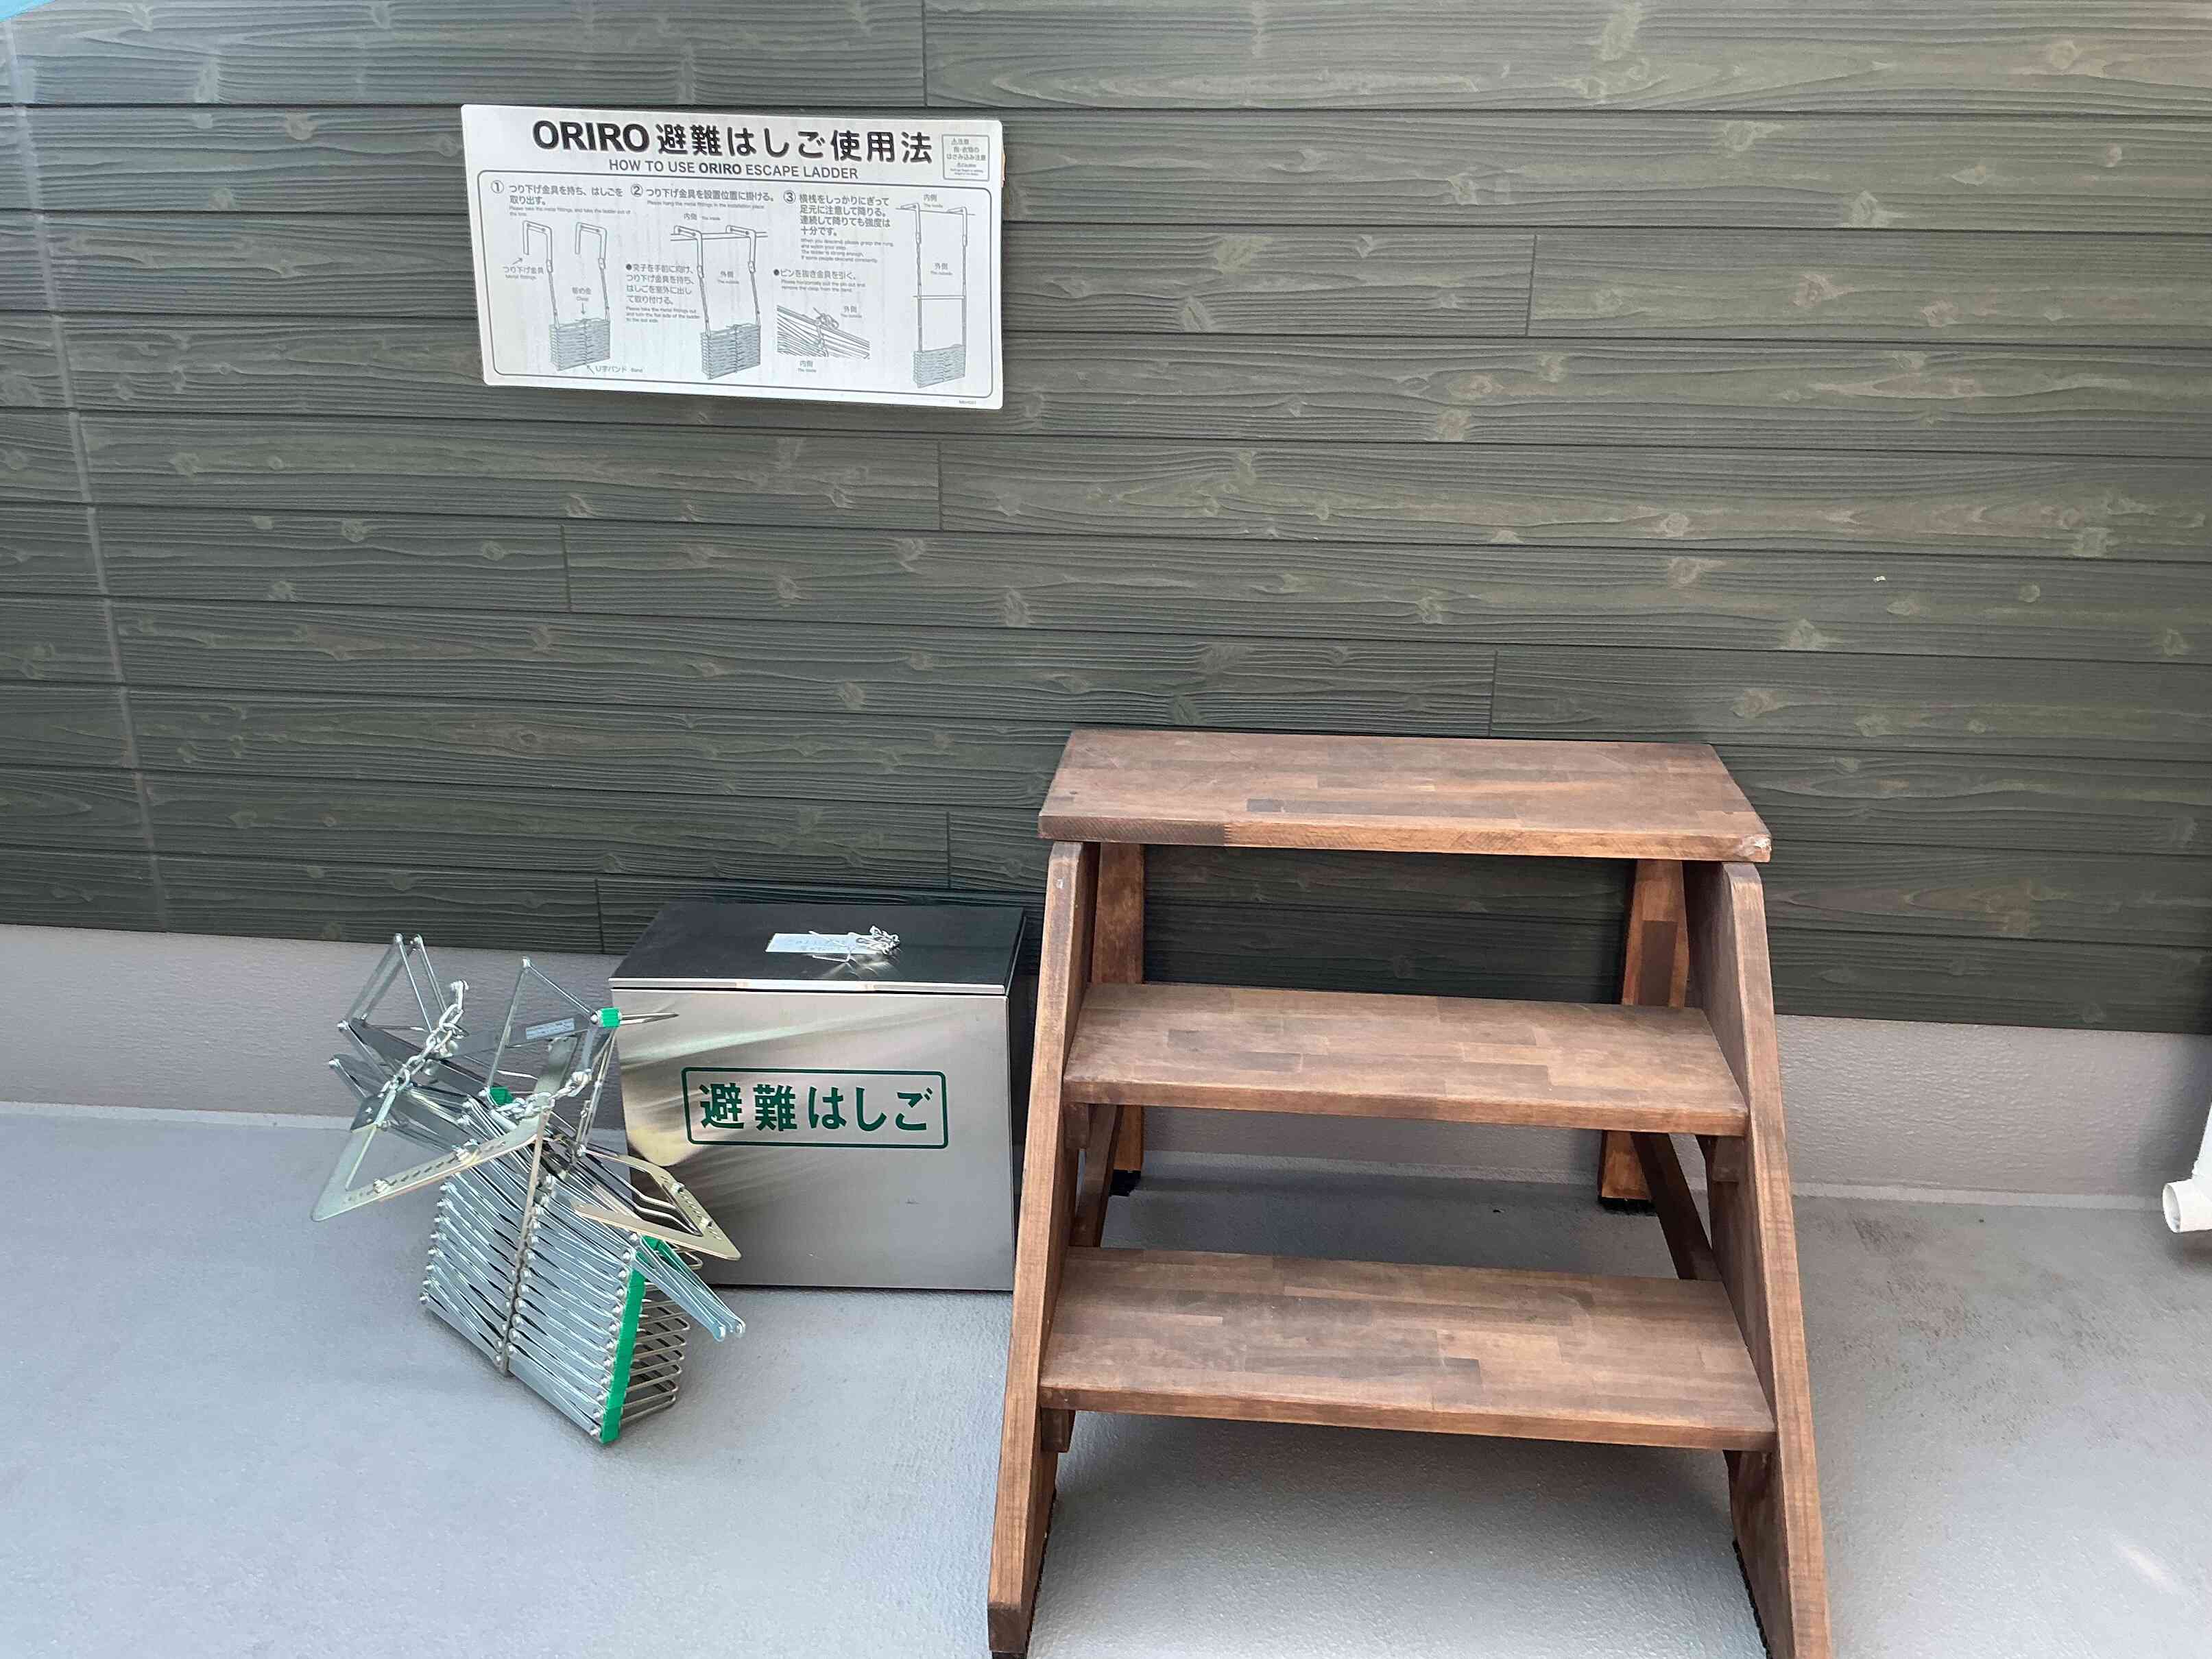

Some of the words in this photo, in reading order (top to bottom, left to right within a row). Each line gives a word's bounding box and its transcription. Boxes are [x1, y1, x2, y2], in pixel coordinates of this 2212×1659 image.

[533, 121, 650, 152] ORIRO
[656, 124, 932, 164] 避難はしご使用法
[609, 159, 640, 171] HOW
[645, 160, 664, 171] TO
[669, 161, 695, 173] USE
[699, 162, 741, 175] ORIRO
[746, 164, 799, 177] ESCAPE
[804, 166, 858, 180] LADDER
[509, 195, 546, 205] 取り出す。
[800, 205, 886, 217] 足元に注意して降りる。
[800, 215, 891, 228] 連続して降りても強度は
[801, 227, 837, 236] 十分です。
[699, 1082, 933, 1132] 避難はしご
